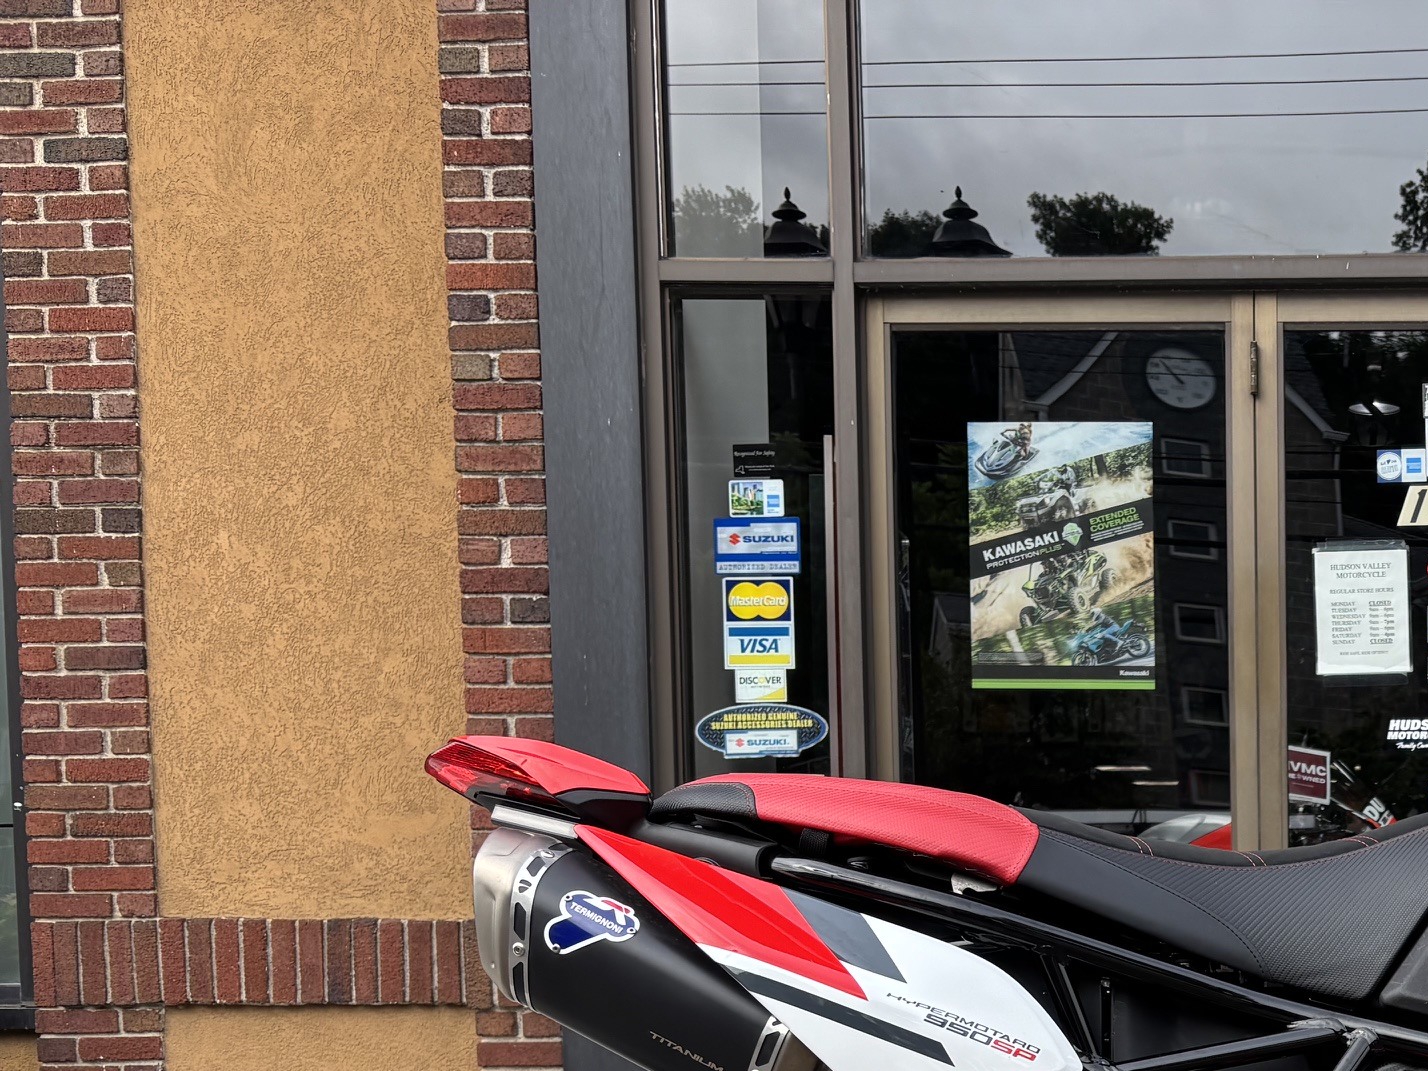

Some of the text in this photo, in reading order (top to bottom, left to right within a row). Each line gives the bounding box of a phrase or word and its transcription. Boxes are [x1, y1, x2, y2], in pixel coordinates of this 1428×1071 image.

[1089, 506, 1137, 526] EXTENDED
[1090, 514, 1141, 533] COVERAGE
[743, 535, 794, 543] SUZUKI
[982, 530, 1060, 562] KAWASAKI
[1330, 562, 1392, 571] HUDSON VALLEY
[1336, 571, 1387, 579] MOTORCYCLE
[730, 596, 786, 606] MasterCard
[738, 638, 780, 654] VISA
[739, 676, 782, 685] DISCOVER
[723, 712, 798, 722] AUTHORIZED GENUINE
[711, 719, 813, 730] SUZUKI ACCESSORIES DEALER
[569, 901, 624, 935] TERMIGNONI
[887, 992, 1041, 1054] HYPERMOTARD
